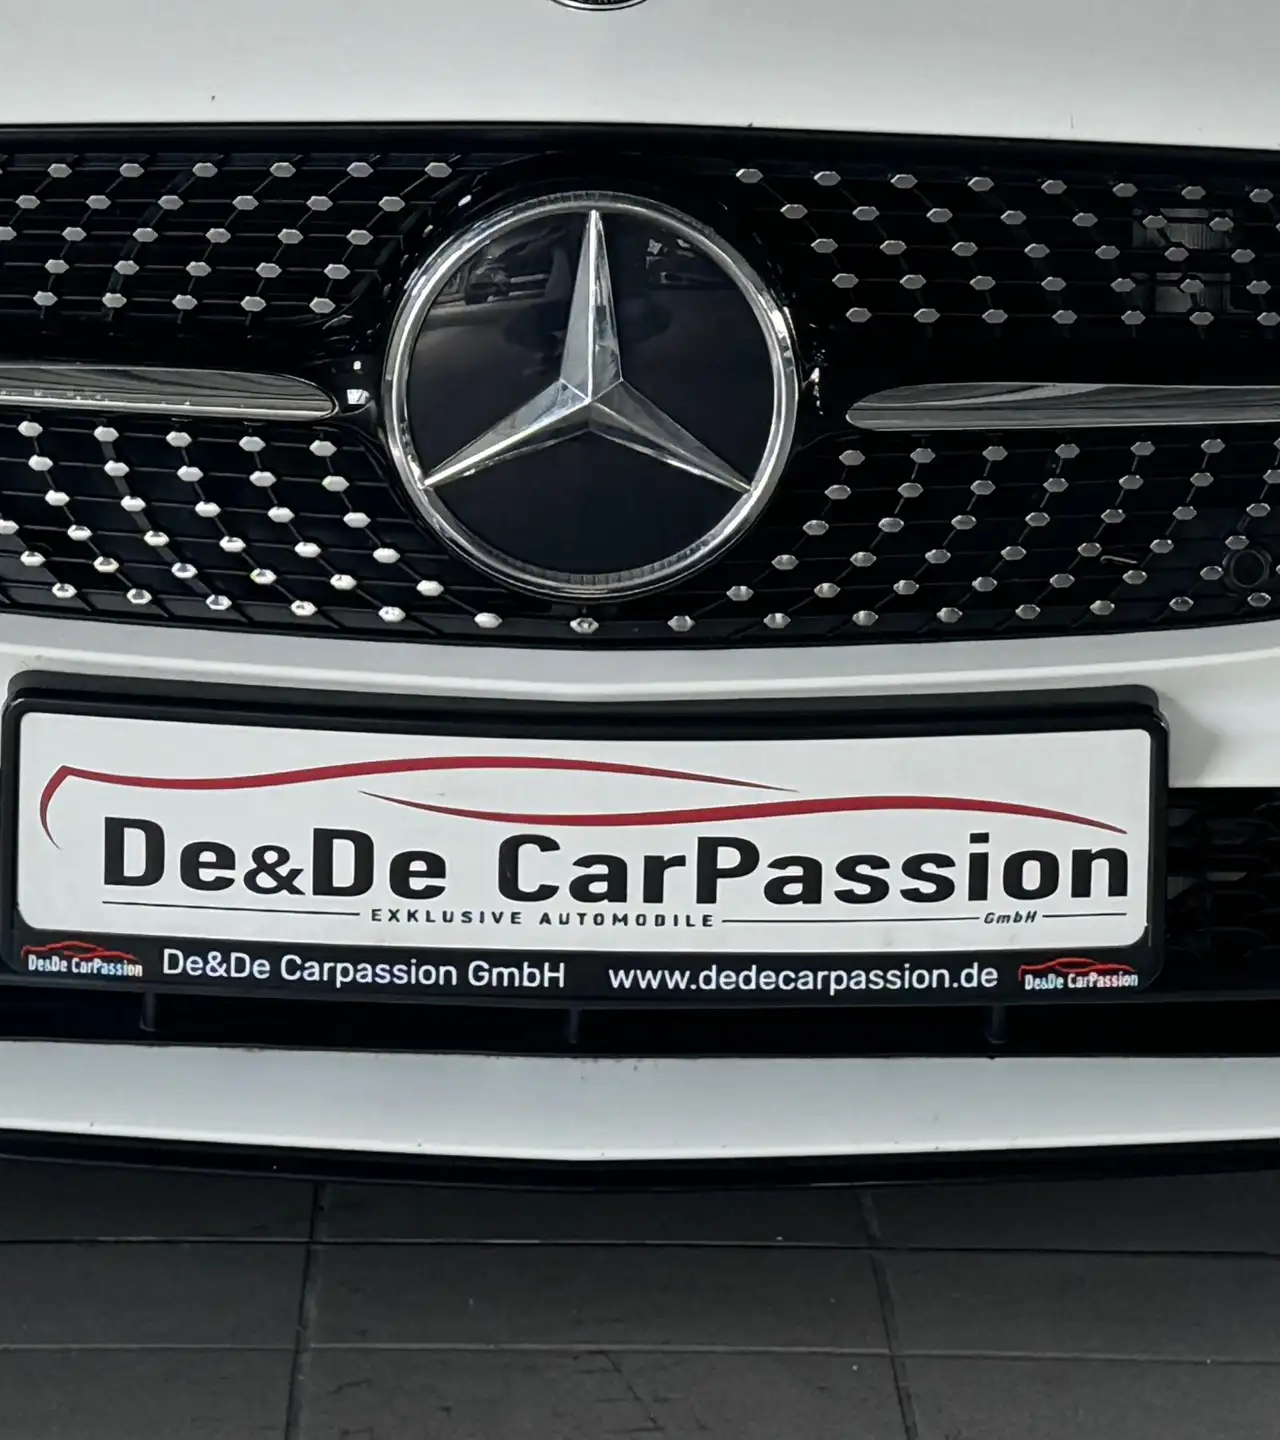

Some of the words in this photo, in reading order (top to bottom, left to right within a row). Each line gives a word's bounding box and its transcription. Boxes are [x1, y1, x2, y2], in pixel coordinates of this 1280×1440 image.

[102, 815, 448, 901] De&De
[497, 831, 1130, 906] CarPassion
[370, 907, 523, 926] EXKLUSIVE
[537, 911, 714, 929] AUTOMOBILE
[983, 910, 1038, 925] GmbH
[70, 956, 144, 978] CarPassion
[162, 947, 272, 980] De&De
[279, 953, 459, 990] Carpassion
[466, 959, 566, 989] GmbH
[608, 960, 1000, 997] www.dedecarpassion.de
[1066, 970, 1139, 990] CarPassion
